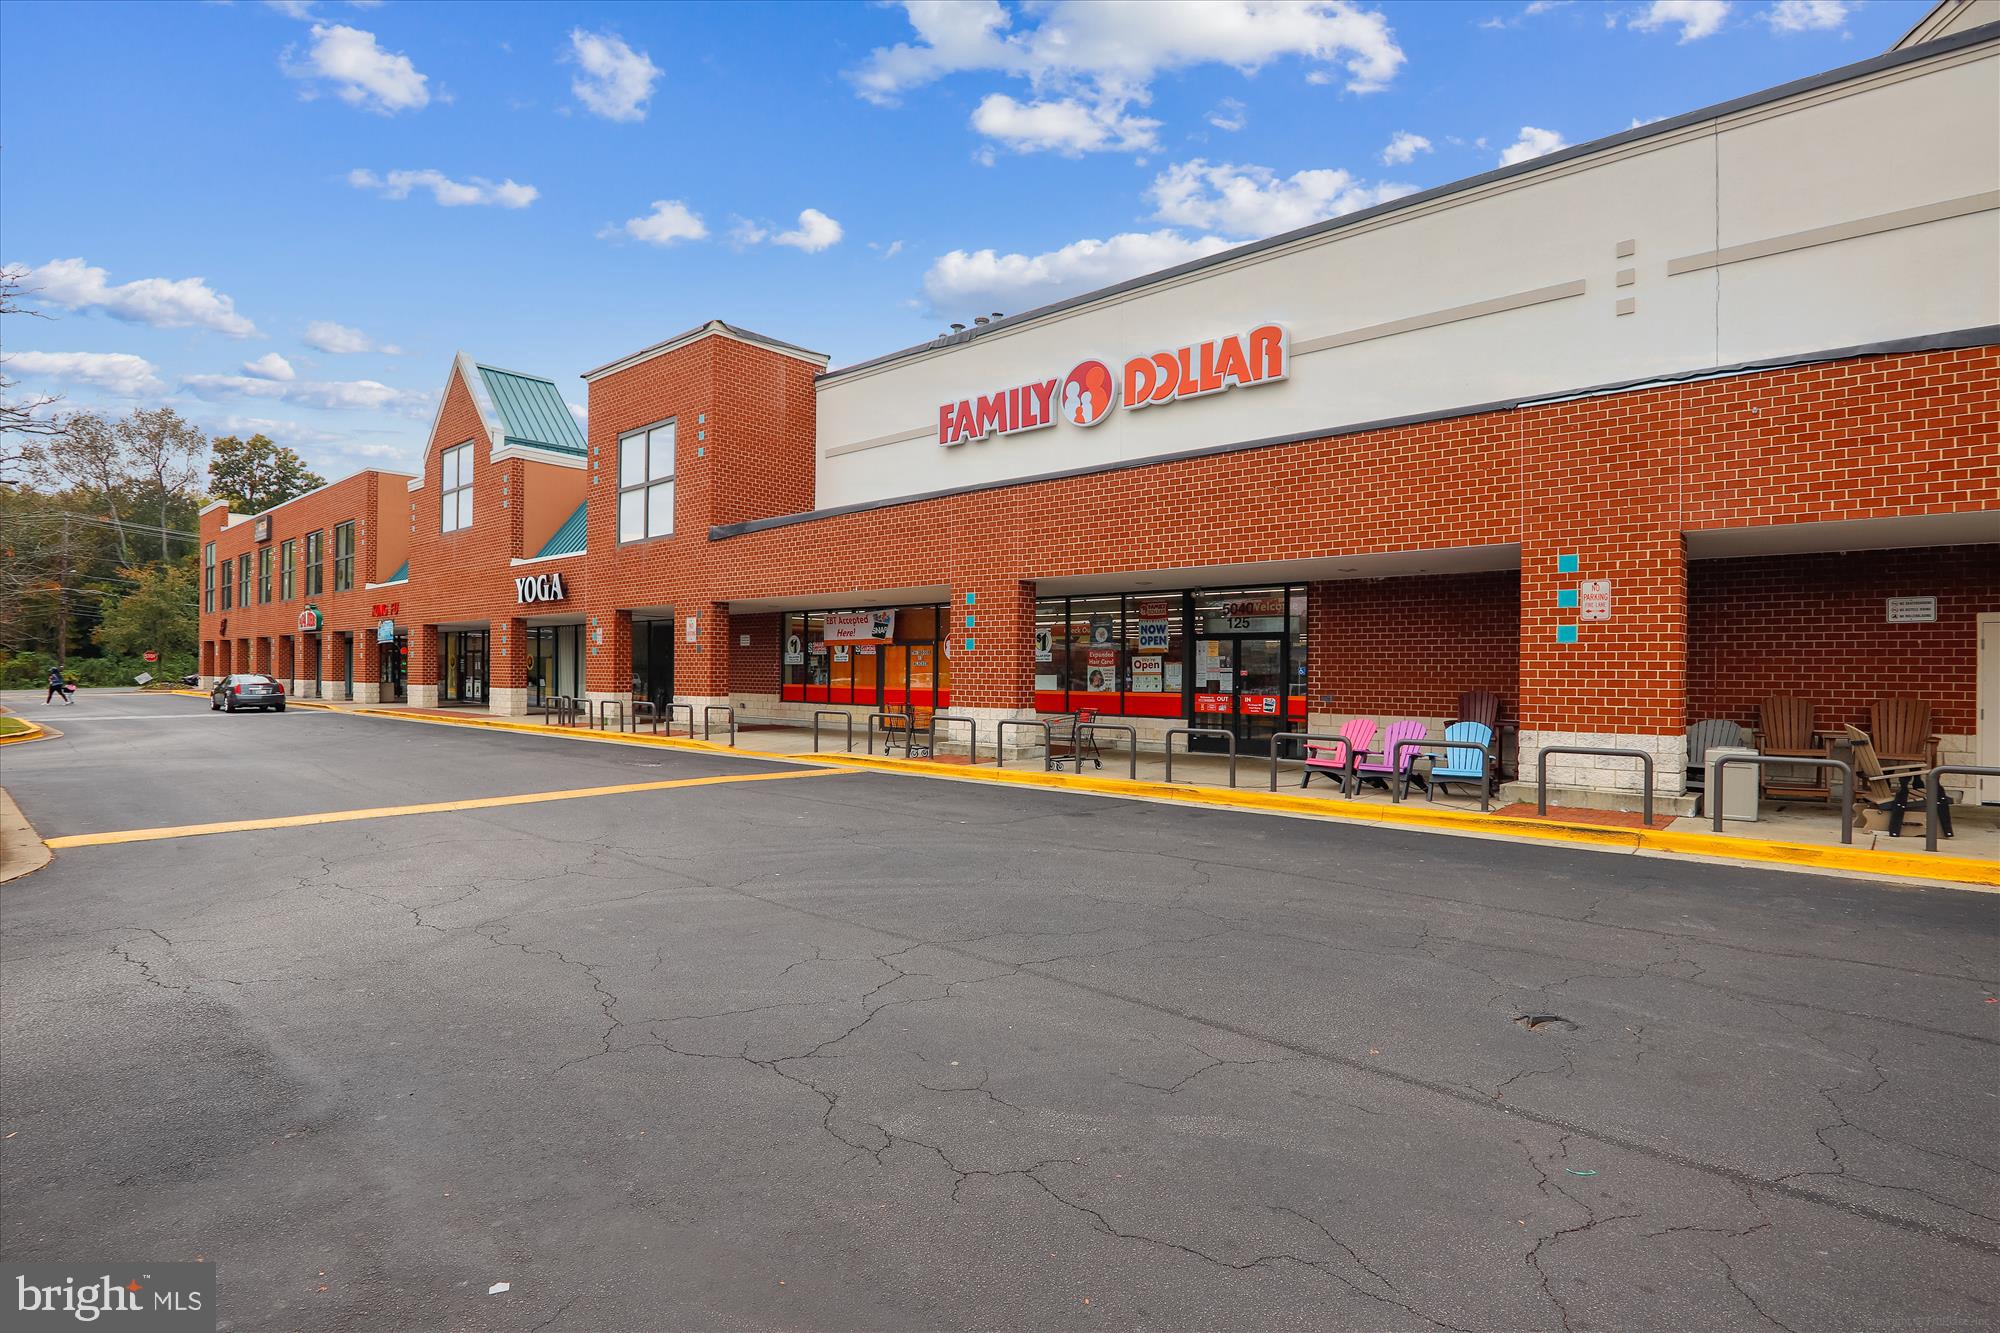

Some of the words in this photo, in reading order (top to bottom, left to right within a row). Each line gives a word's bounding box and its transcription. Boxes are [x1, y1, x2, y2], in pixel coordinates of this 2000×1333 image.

[938, 377, 1059, 445] FAMILY
[1123, 324, 1284, 408] DOLLAR
[514, 573, 564, 603] YOGA
[1583, 593, 1609, 601] PARKING
[1222, 602, 1253, 615] 5040
[826, 616, 837, 625] EBT
[838, 614, 869, 627] Accepted
[1227, 617, 1250, 629] 125
[837, 628, 856, 637] Here!
[1141, 624, 1167, 635] NOW
[1140, 635, 1167, 646] OPEN
[1090, 651, 1114, 659] Expanded
[1133, 660, 1160, 672] Open
